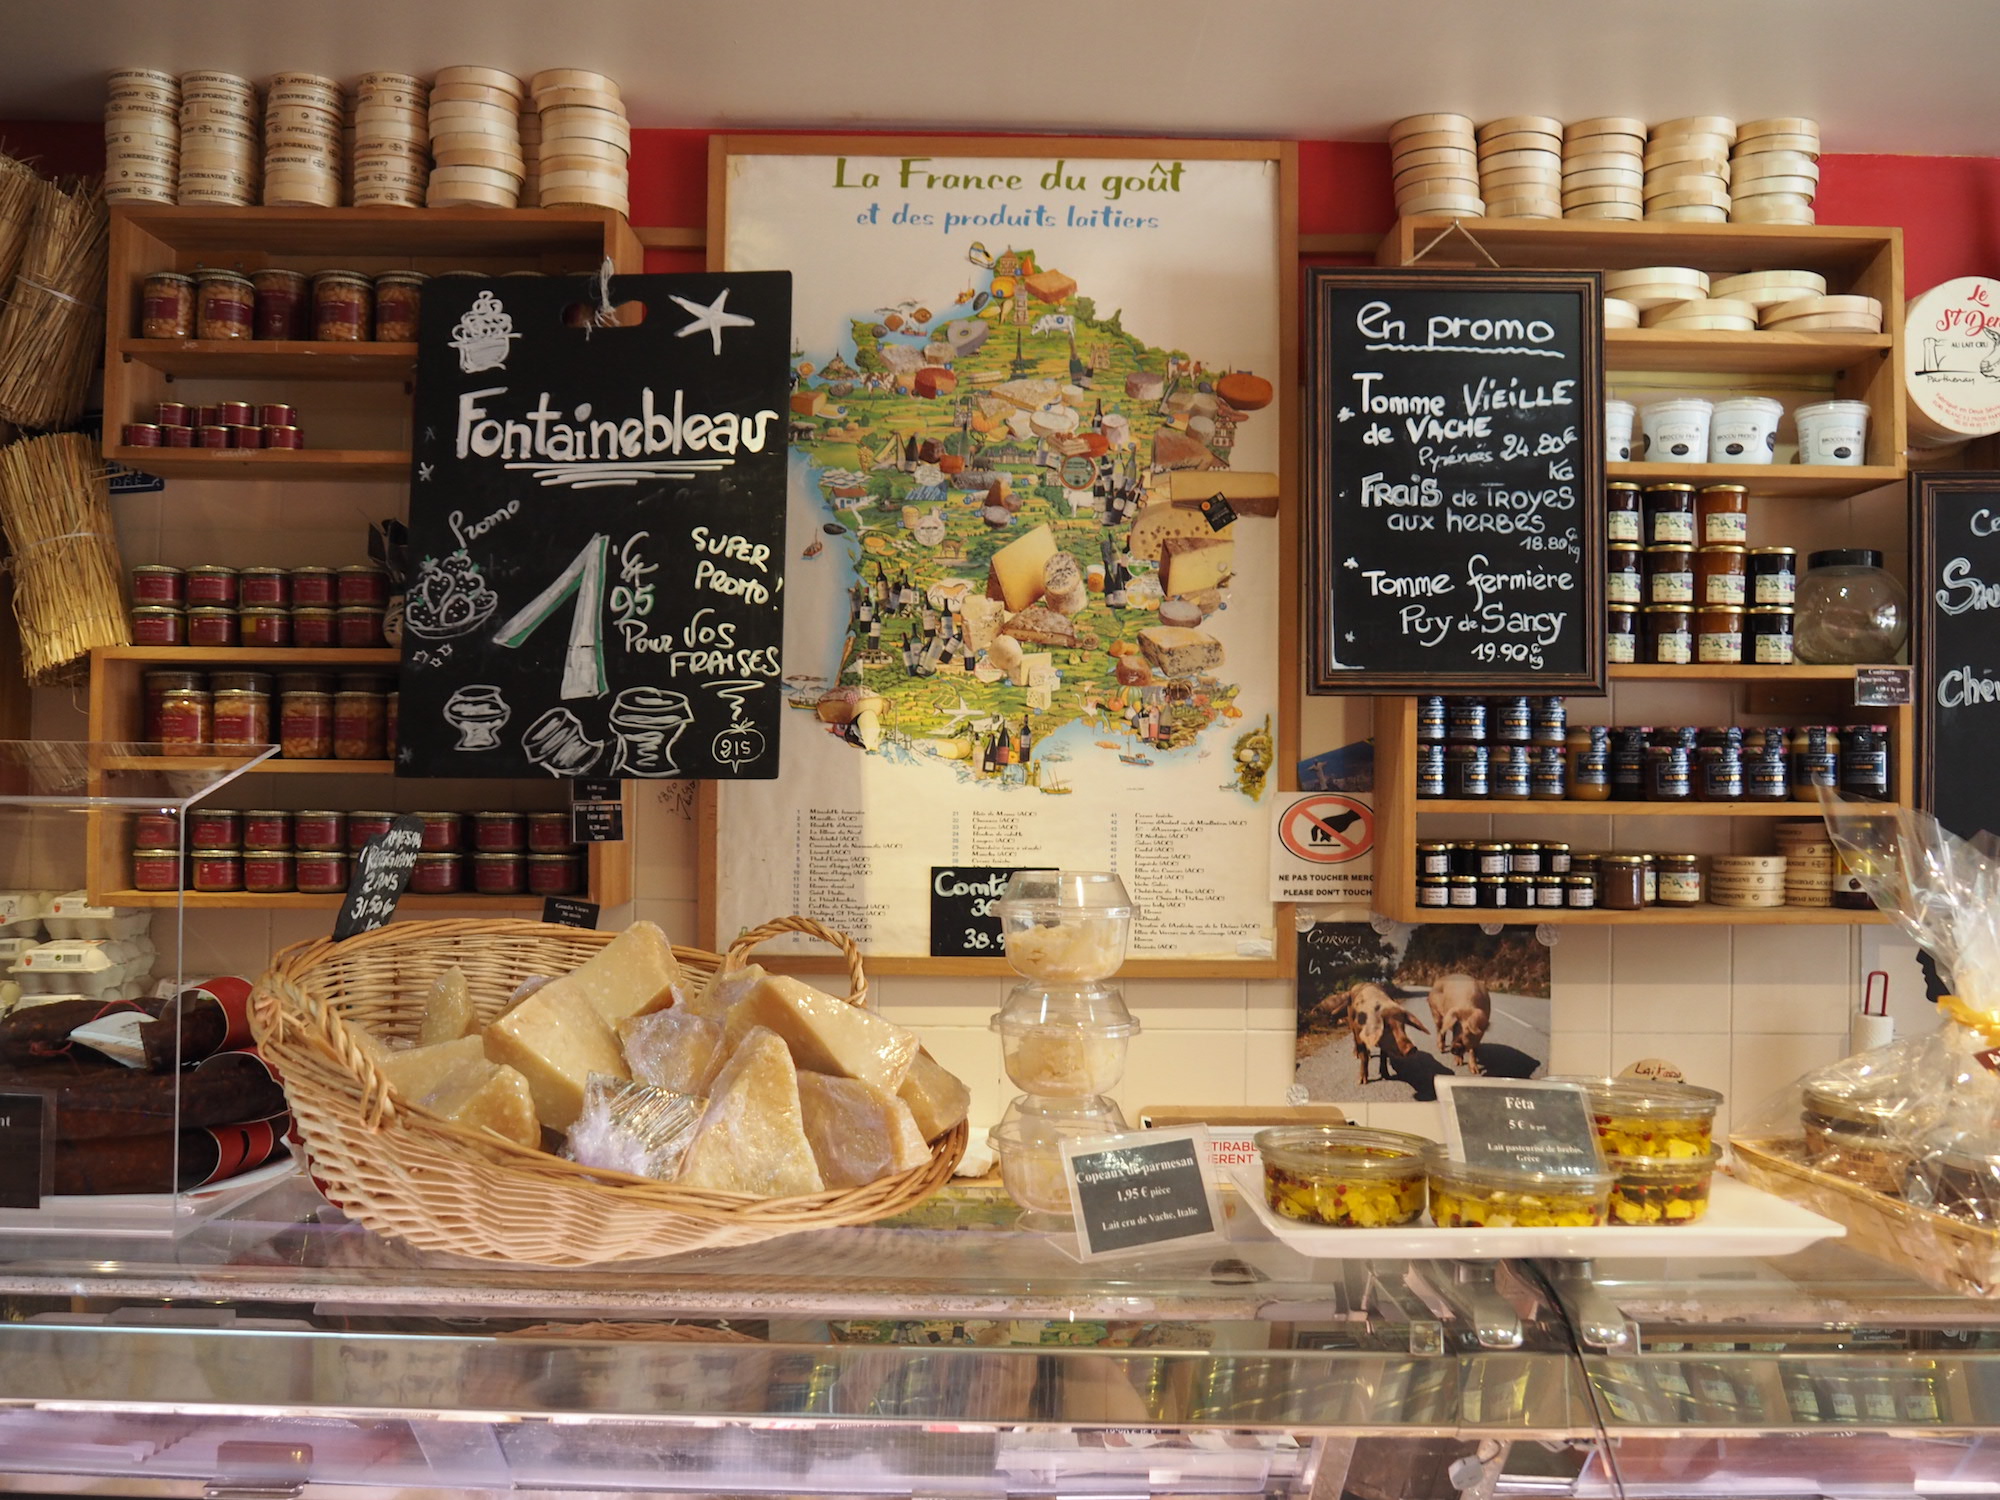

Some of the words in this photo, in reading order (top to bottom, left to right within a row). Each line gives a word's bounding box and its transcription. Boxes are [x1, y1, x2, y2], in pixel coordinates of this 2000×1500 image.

[832, 157, 879, 189] La
[899, 158, 1022, 191] France
[1040, 159, 1086, 191] du
[1101, 160, 1186, 200] goût
[856, 202, 880, 226] et
[891, 202, 934, 226] des
[944, 204, 1056, 234] produits
[1066, 205, 1159, 229] laitiers
[1967, 284, 1990, 308] Le
[1356, 300, 1405, 341] En
[1427, 315, 1556, 346] promo
[1352, 371, 1446, 417] Tomme
[455, 386, 780, 460] Fontainebleau
[1362, 421, 1395, 447] de
[1405, 415, 1493, 445] VACHE
[1451, 488, 1479, 508] de
[1387, 512, 1435, 532] aux
[1361, 569, 1455, 598] Tomme
[1466, 553, 1575, 612] fermière
[1399, 604, 1454, 648] Puy
[1457, 614, 1479, 632] de
[1481, 601, 1568, 646] Sancy
[669, 646, 782, 678] FRAISES
[1278, 874, 1291, 882] NE
[1292, 874, 1308, 882] PAS
[1309, 874, 1349, 882] TOUCHER
[1504, 1096, 1535, 1111] Féta
[1075, 1165, 1125, 1185] Copeaux
[1143, 1156, 1194, 1177] parmesan
[1116, 1187, 1139, 1203] 1,95
[1141, 1186, 1149, 1198] €
[1150, 1185, 1171, 1199] pièce
[1101, 1219, 1120, 1231] Lait
[1121, 1218, 1136, 1228] cru
[1137, 1215, 1148, 1225] de
[1177, 1206, 1199, 1219] Italie
